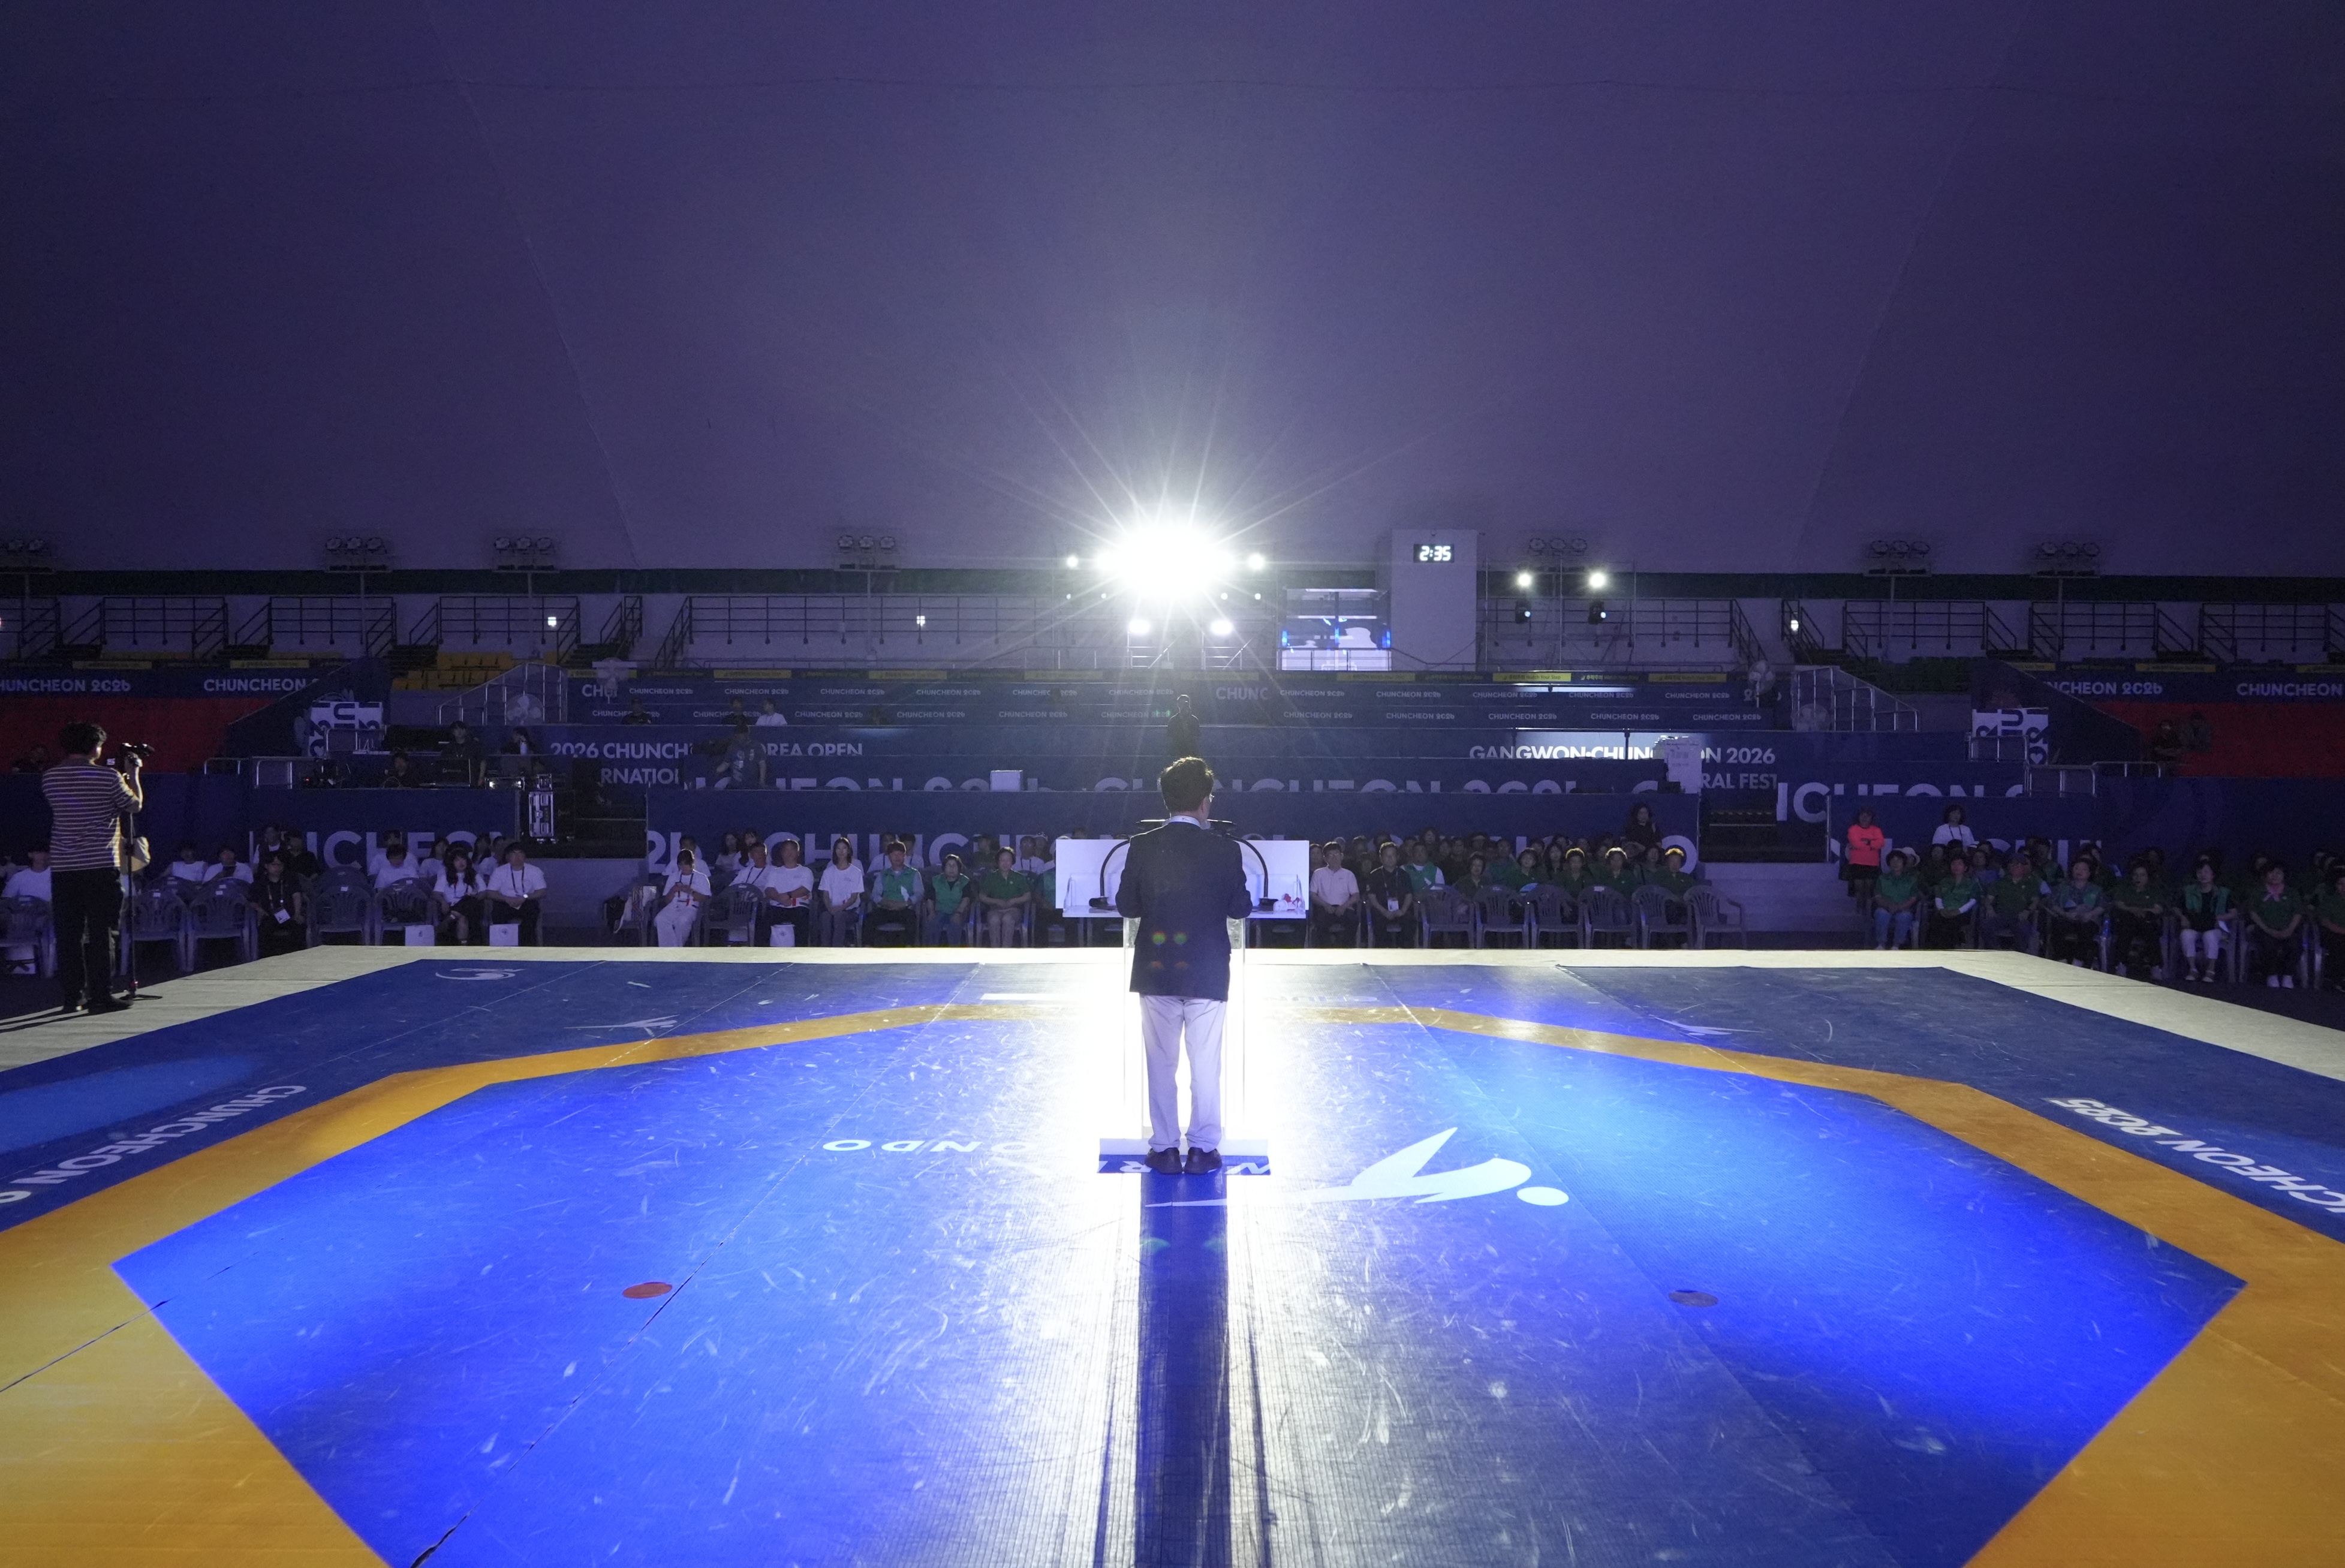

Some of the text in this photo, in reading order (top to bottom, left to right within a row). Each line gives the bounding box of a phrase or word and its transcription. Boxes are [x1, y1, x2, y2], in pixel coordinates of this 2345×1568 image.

[1419, 545, 1452, 561] 2:35
[91, 679, 131, 692] 2026
[203, 678, 306, 692] CHUNCHEON
[2121, 681, 2163, 695] 2026
[2236, 682, 2343, 697] CHUNCHEON
[550, 742, 598, 759] 2026
[1726, 747, 1776, 765] 2026
[2049, 1100, 2183, 1136] 2025
[10, 1085, 307, 1184] CHUNCHEON
